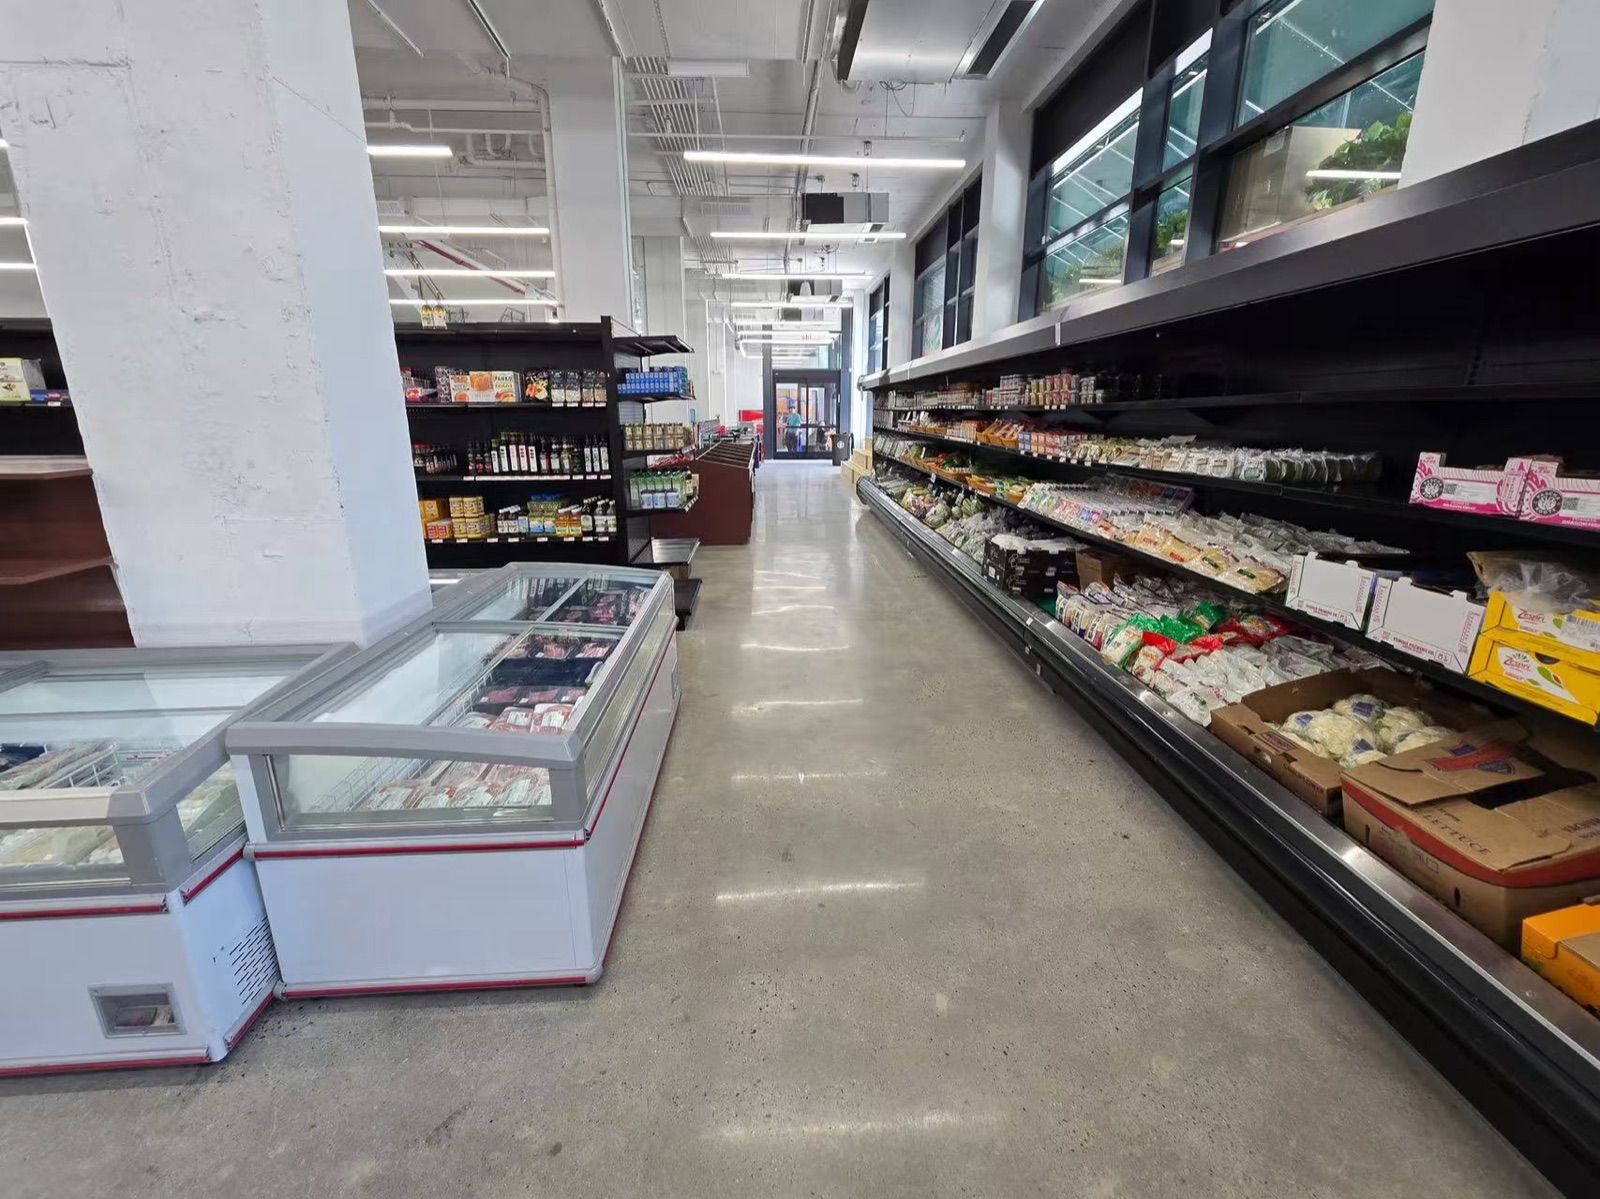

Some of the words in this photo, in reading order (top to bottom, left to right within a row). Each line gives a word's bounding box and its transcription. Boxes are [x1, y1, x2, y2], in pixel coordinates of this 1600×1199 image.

[1518, 609, 1545, 622] Zespri
[1504, 656, 1531, 670] Zespri
[1424, 814, 1491, 855] LETTUCE
